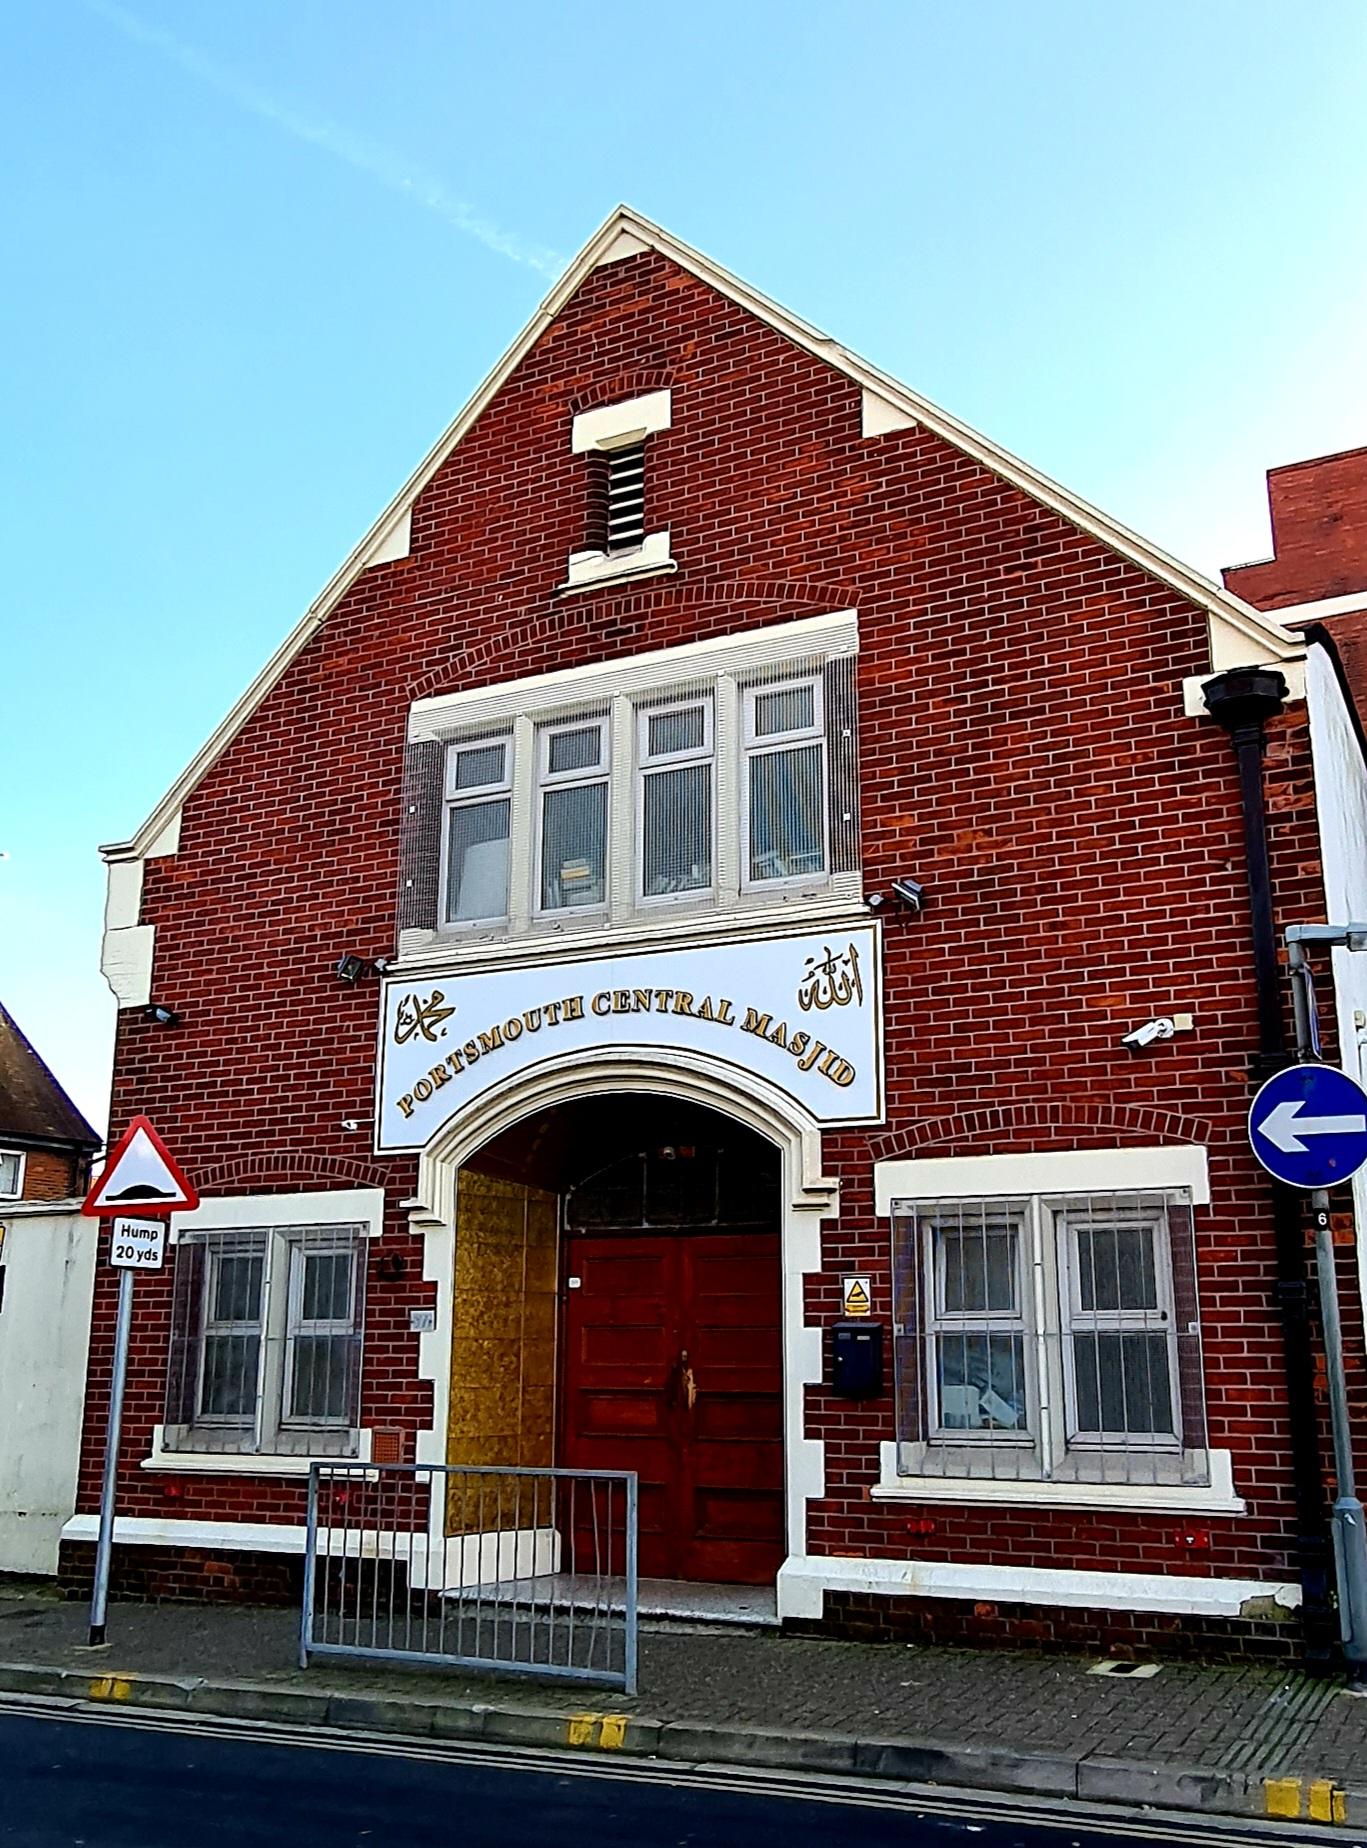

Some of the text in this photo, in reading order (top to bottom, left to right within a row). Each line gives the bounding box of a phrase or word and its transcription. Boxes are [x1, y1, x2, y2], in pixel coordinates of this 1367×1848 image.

[396, 989, 856, 1118] PORTSMOUTH CENTRAL MASJID
[1318, 1212, 1327, 1225] 6
[121, 1224, 159, 1242] Hump
[116, 1245, 158, 1263] 20 yds
